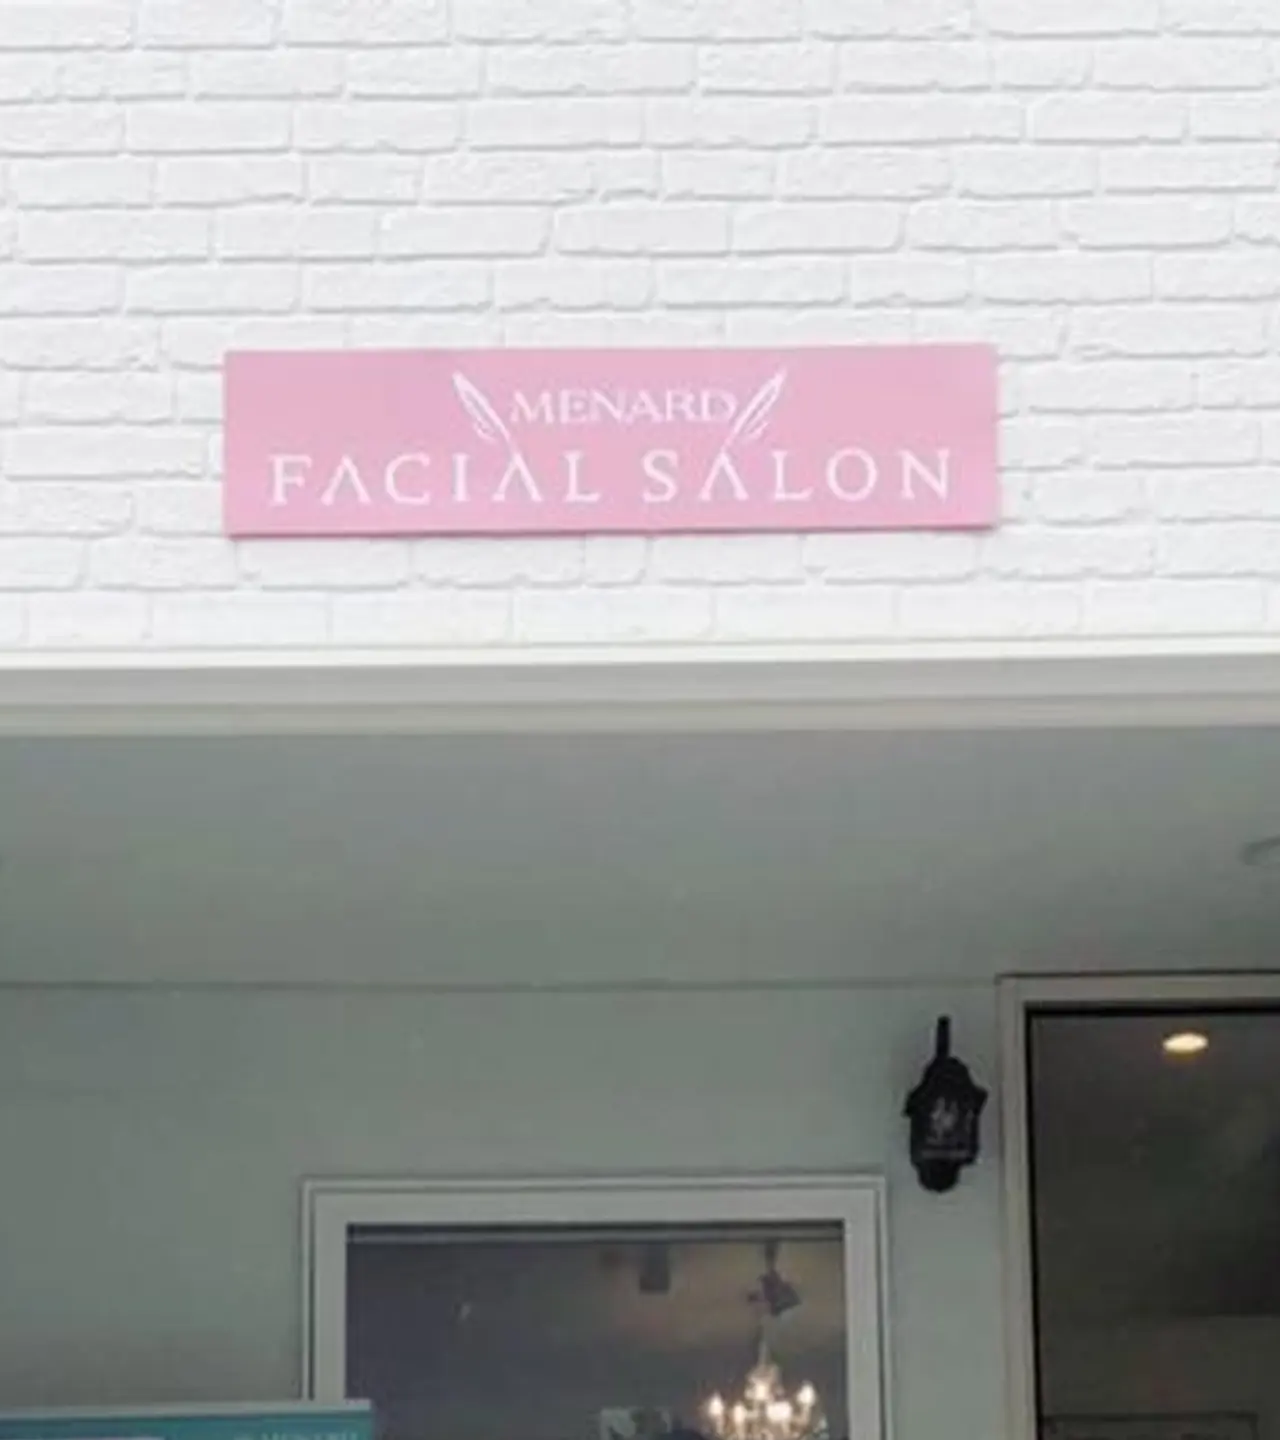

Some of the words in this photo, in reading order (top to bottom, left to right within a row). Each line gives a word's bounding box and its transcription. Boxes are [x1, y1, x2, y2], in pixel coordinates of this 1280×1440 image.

[511, 388, 734, 424] MENARD
[269, 450, 602, 506] FACIAL
[642, 447, 952, 503] SALON
